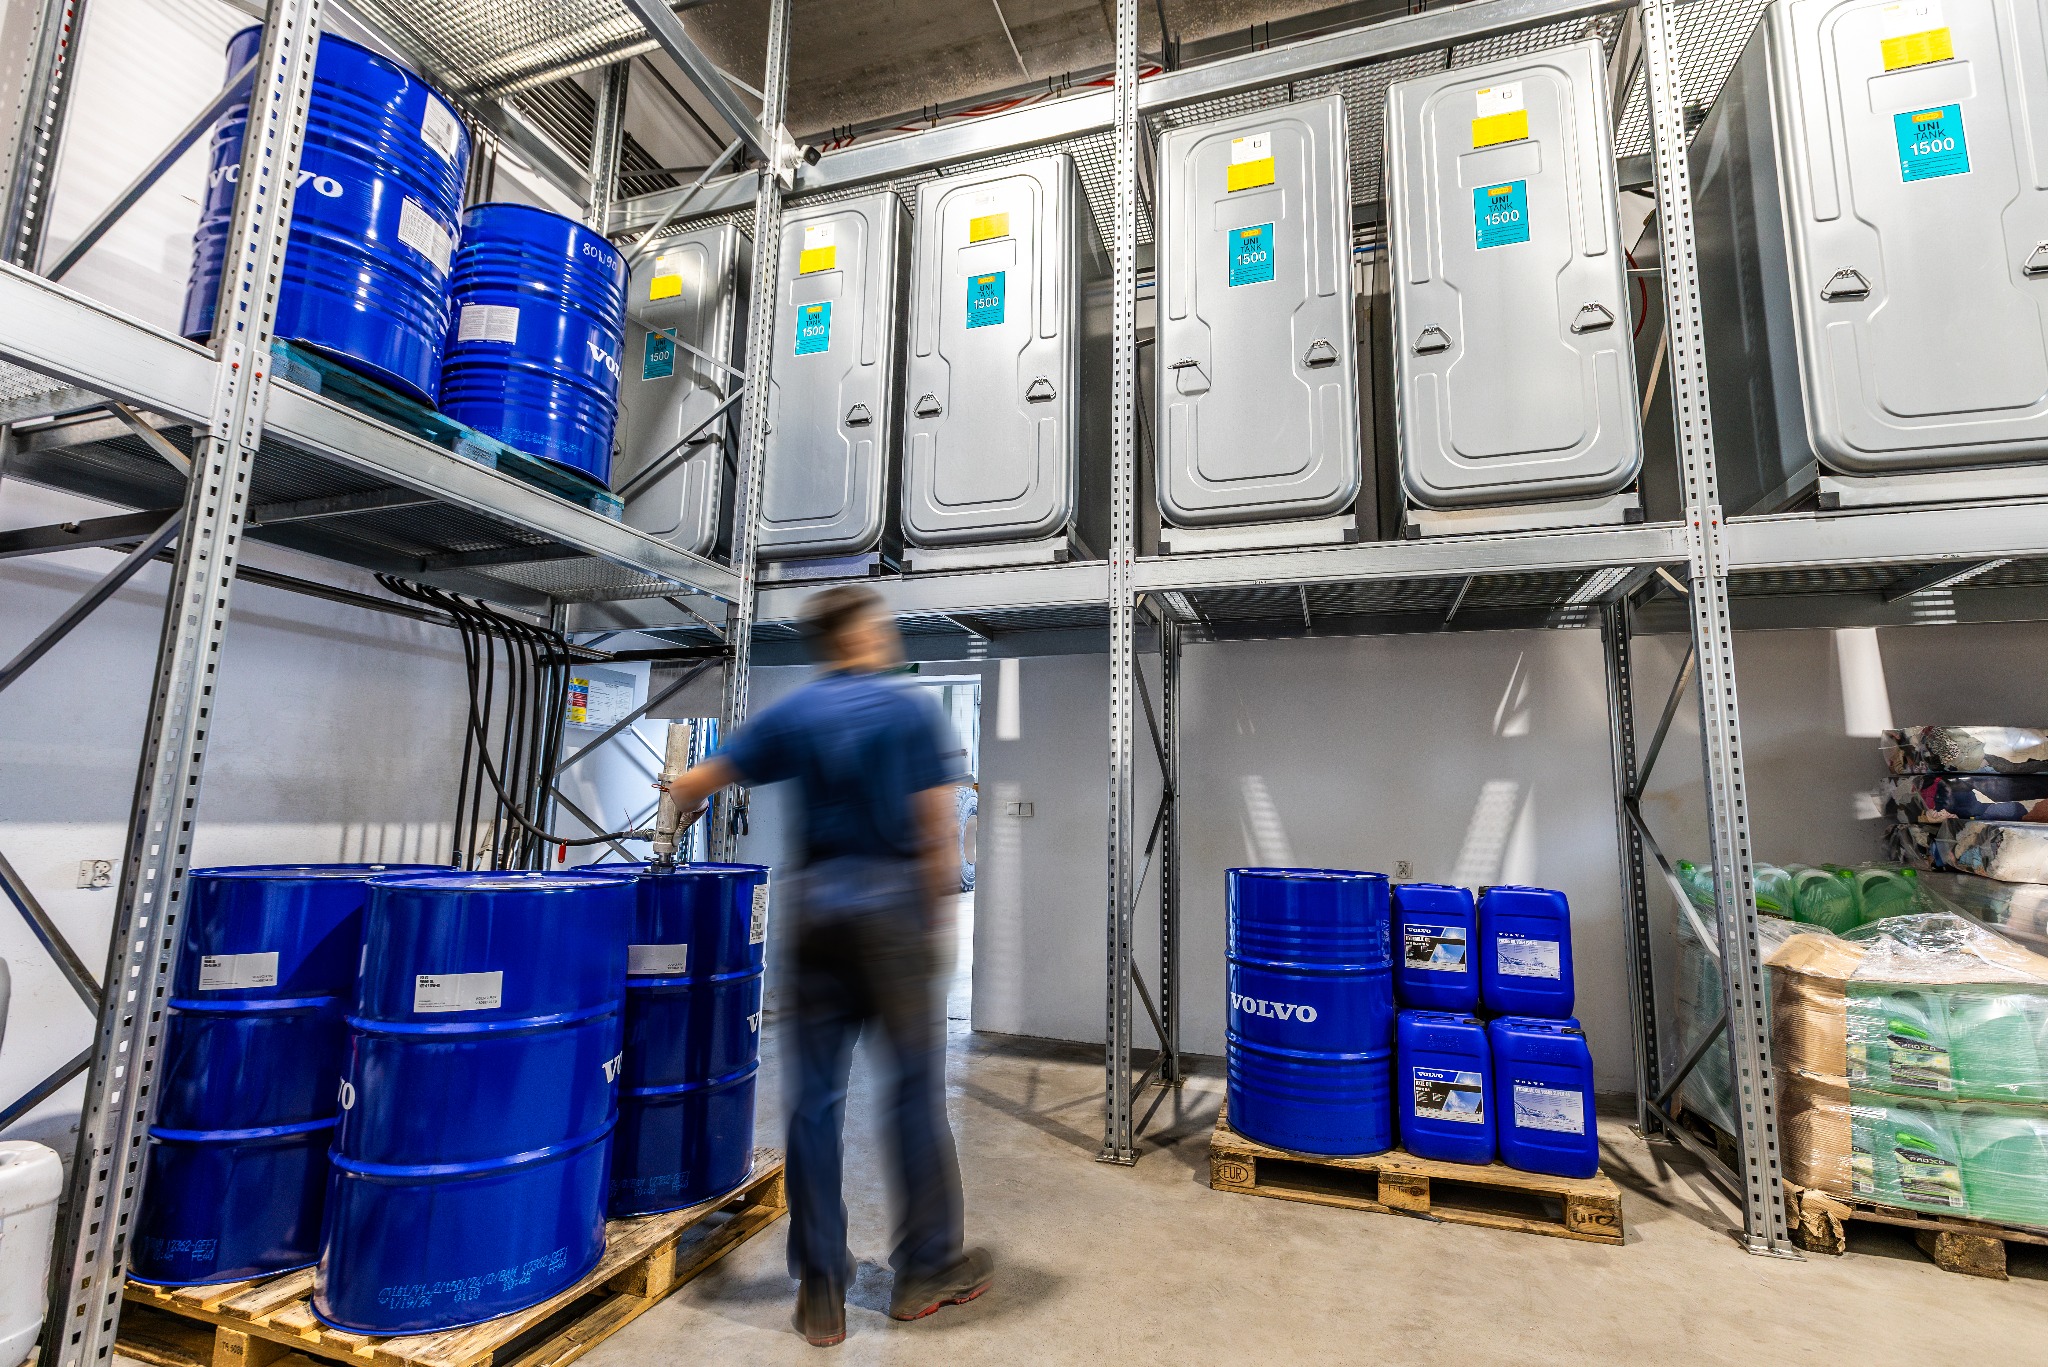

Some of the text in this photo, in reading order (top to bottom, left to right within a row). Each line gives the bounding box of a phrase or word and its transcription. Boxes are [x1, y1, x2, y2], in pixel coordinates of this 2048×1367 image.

[1917, 121, 1940, 132] UNI
[1914, 129, 1947, 141] TANK
[1910, 137, 1955, 156] 1500
[1491, 195, 1509, 205] UNI
[1488, 201, 1513, 212] TANK
[1484, 209, 1520, 226] 1500
[1243, 237, 1259, 245] UNI
[1240, 244, 1262, 253] TANK
[1237, 250, 1267, 265] 1500
[974, 296, 999, 309] 1500
[802, 325, 825, 337] 1500
[650, 350, 670, 362] 1500
[1231, 991, 1318, 1023] VOLVO
[1417, 1071, 1444, 1079] VOLVO
[1223, 1166, 1242, 1181] EUR
